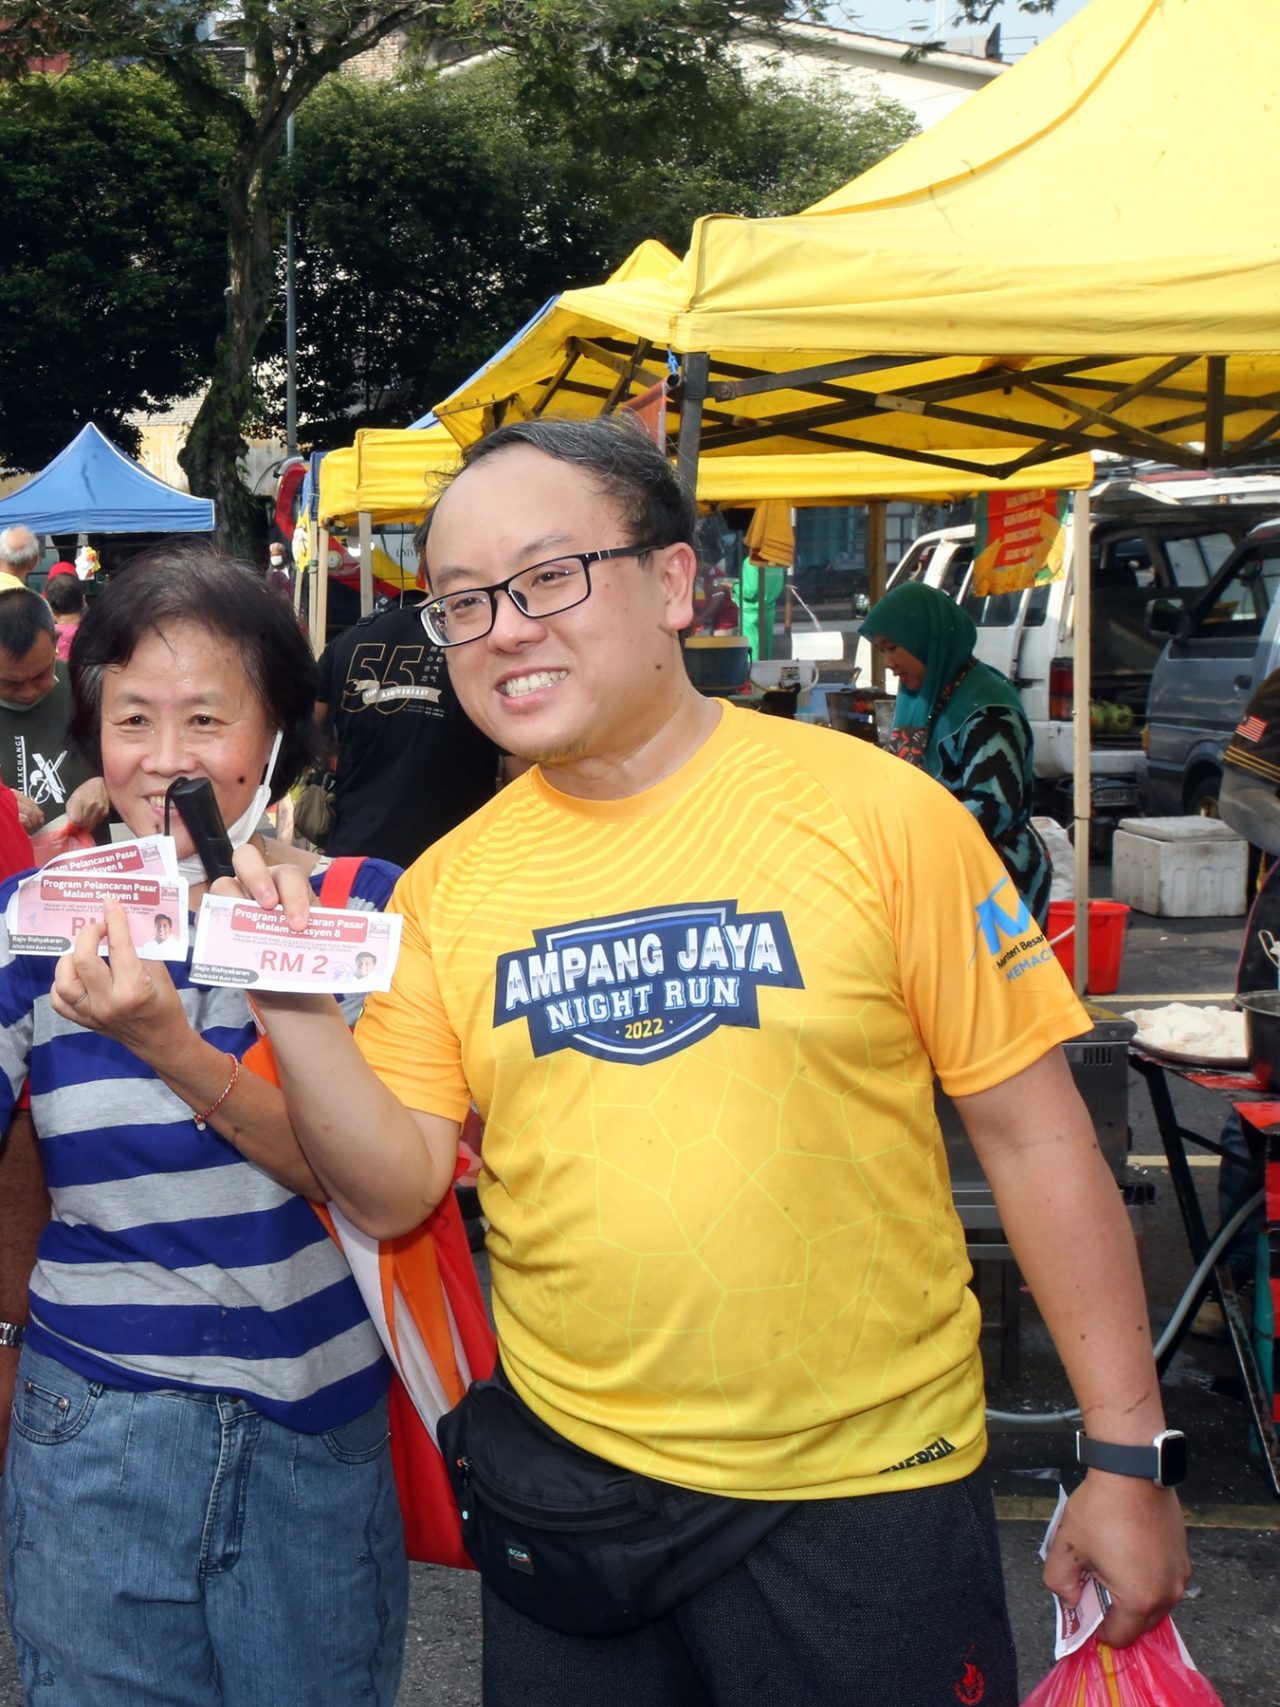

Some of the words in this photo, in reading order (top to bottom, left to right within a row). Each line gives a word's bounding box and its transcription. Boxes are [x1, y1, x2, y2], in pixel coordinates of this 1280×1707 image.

[341, 643, 424, 714] 55
[14, 735, 24, 783] EXCHANGE
[70, 855, 115, 870] Pelancaran
[115, 850, 138, 859] Pasar
[117, 862, 124, 870] 8
[43, 880, 82, 890] Program
[83, 880, 133, 890] Pelancaran
[134, 883, 157, 893] Pasar
[63, 890, 93, 899] Malam
[95, 891, 132, 901] Seksyen
[133, 893, 139, 901] 8
[234, 908, 277, 922] Program
[337, 919, 365, 929] Pasar
[255, 922, 289, 933] Malam
[334, 930, 341, 938] 8
[1019, 933, 1044, 951] Besar
[260, 950, 304, 971] RM
[311, 955, 328, 975] 2
[505, 933, 665, 1010] AMPANG
[677, 922, 784, 974] JAYA
[546, 982, 653, 1034] NIGHT
[663, 976, 740, 1010] RUN
[624, 1018, 665, 1040] 2022
